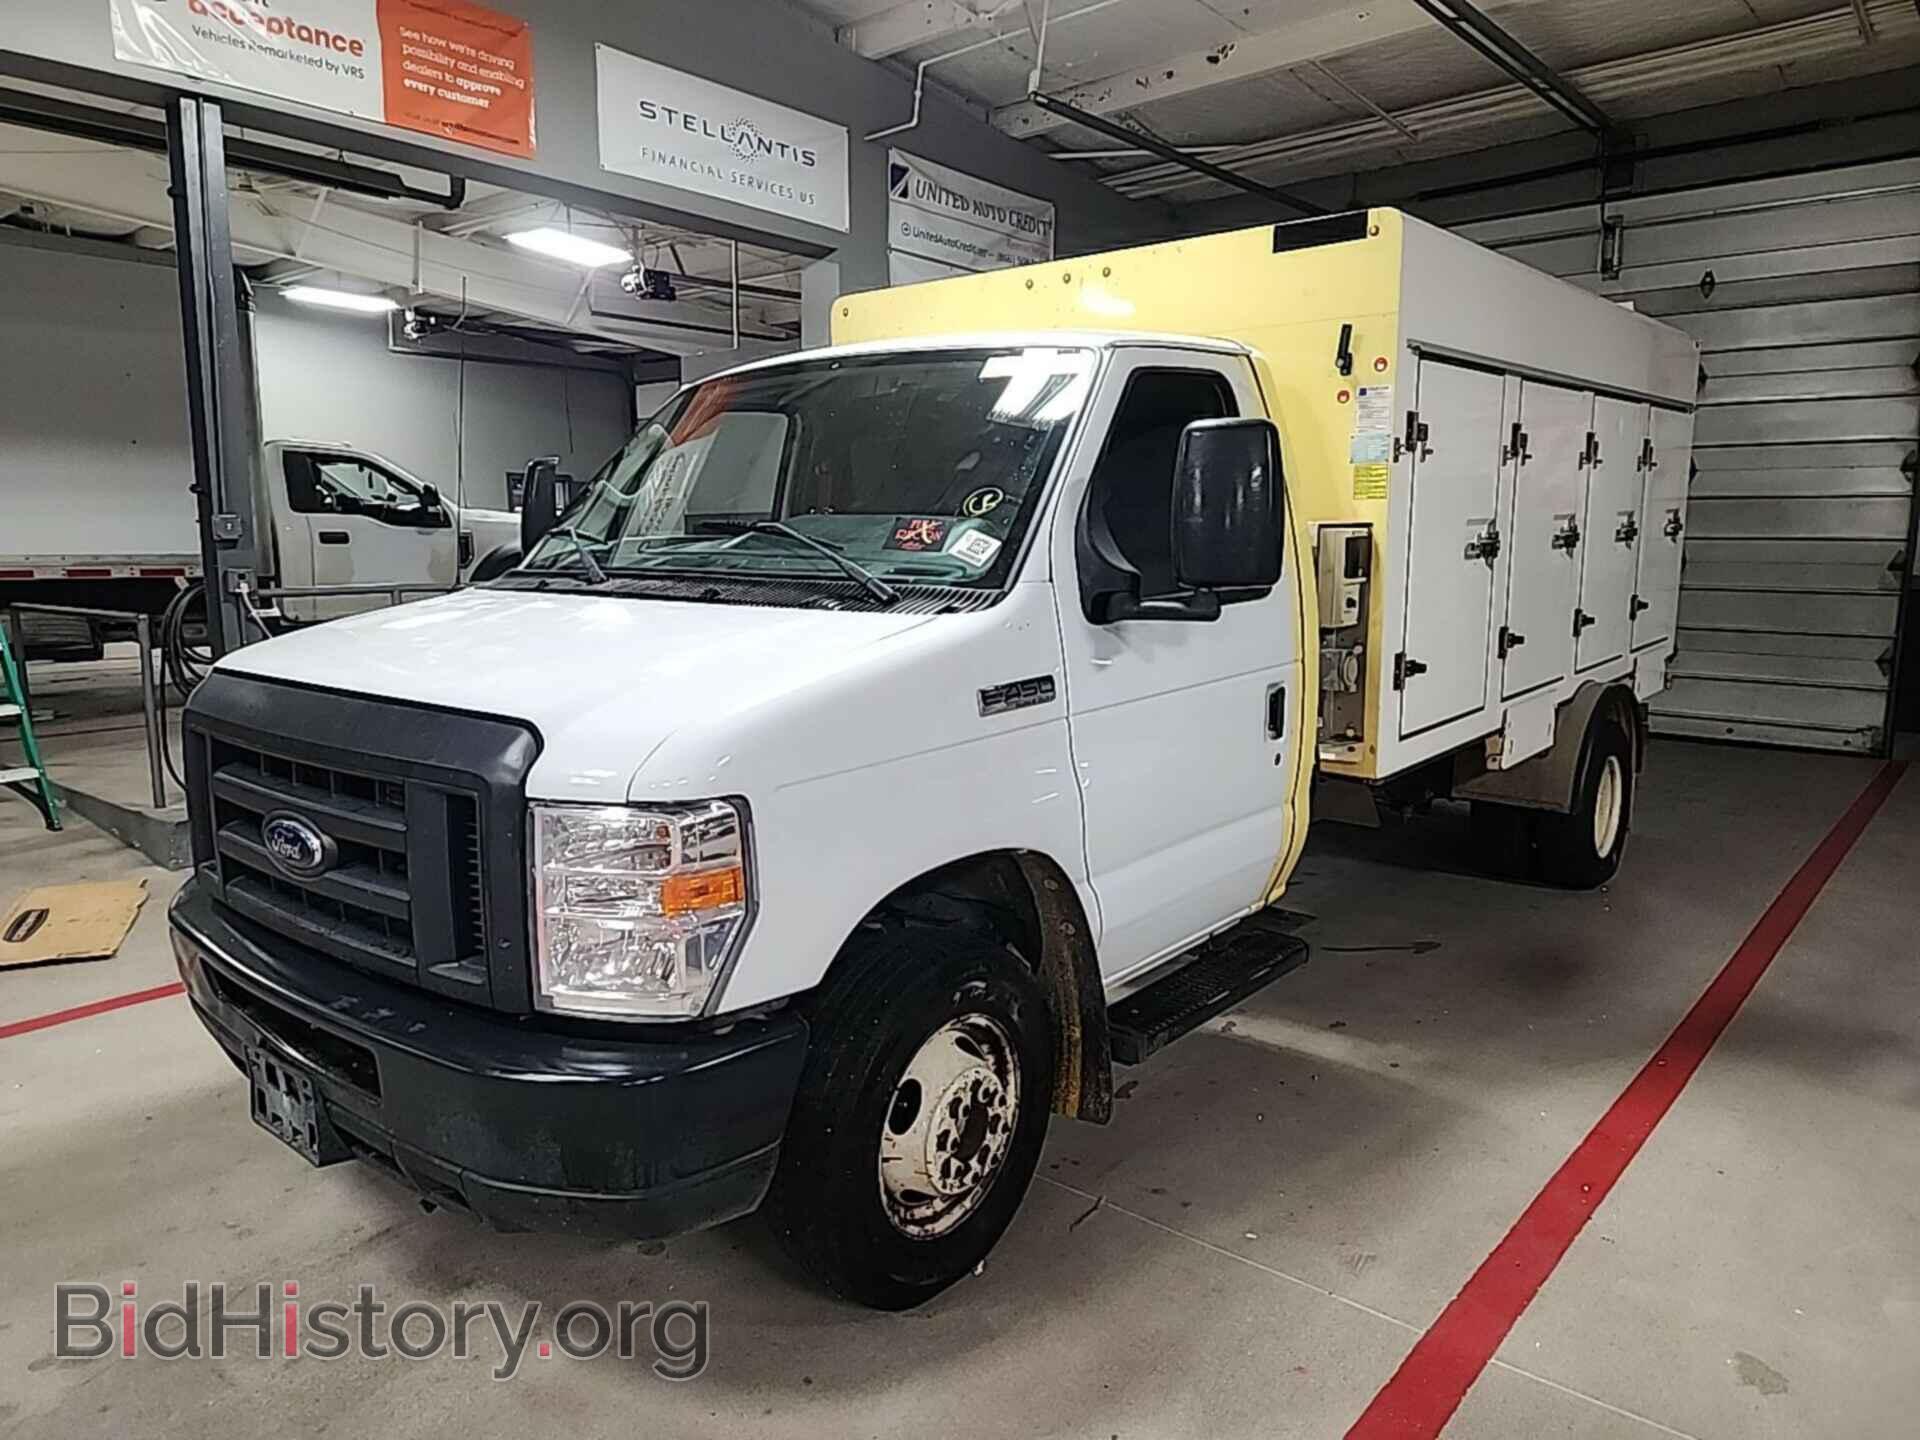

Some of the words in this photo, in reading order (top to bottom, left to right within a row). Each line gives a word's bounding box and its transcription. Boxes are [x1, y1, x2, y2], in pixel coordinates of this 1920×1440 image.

[191, 24, 247, 50] Vehicles
[325, 58, 340, 75] by
[342, 63, 365, 80] VRS
[421, 32, 448, 48] how
[401, 44, 456, 69] possibility
[456, 61, 478, 75] and
[402, 60, 443, 81] dealers
[444, 72, 456, 84] to
[455, 77, 502, 97] approve
[403, 78, 437, 97] every
[436, 87, 490, 109] customer
[639, 100, 817, 168] STELLANTIS
[641, 147, 724, 181] FINANCIAL
[730, 170, 794, 200] SERVICES
[799, 190, 817, 206] US
[914, 178, 970, 212] UNITED
[972, 199, 1008, 224] AUTO
[1008, 210, 1049, 237] CREDIT
[271, 827, 301, 860] Ford
